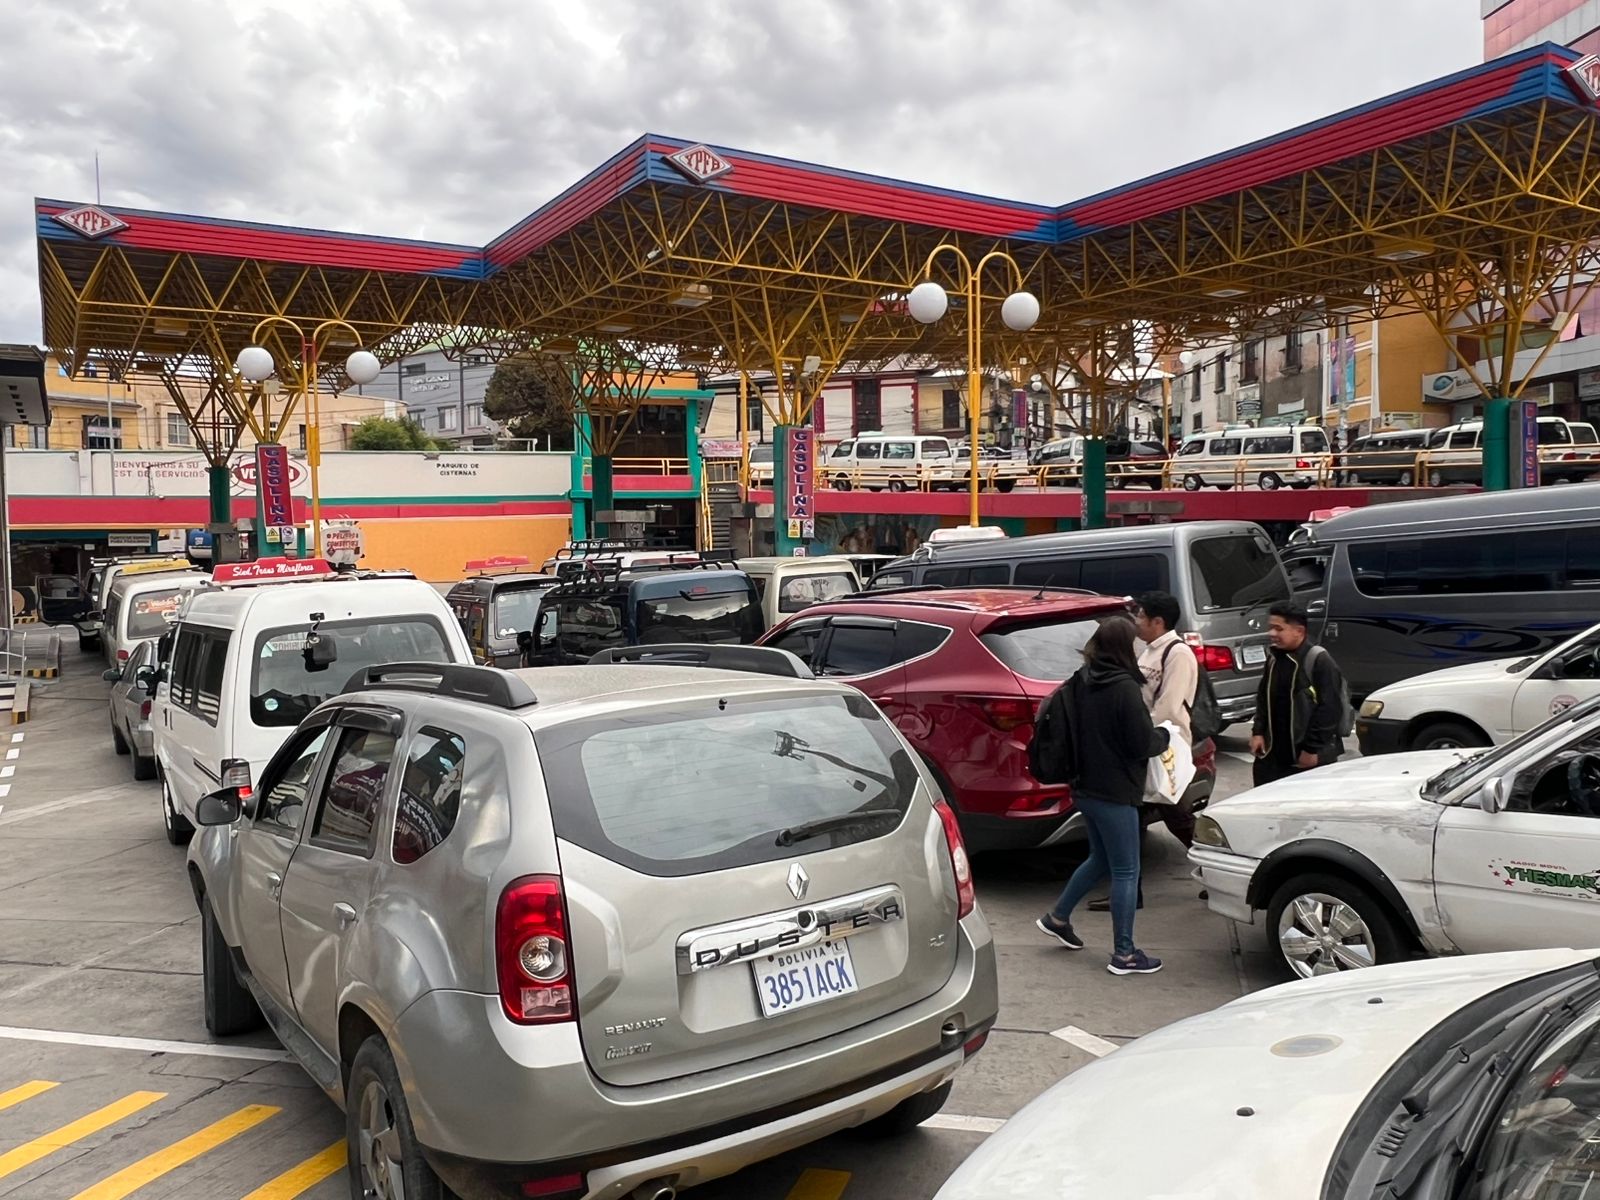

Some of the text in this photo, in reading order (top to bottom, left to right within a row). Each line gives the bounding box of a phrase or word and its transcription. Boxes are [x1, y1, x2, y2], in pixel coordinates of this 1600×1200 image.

[685, 150, 720, 175] YPFB
[71, 210, 112, 231] YPFB
[1525, 402, 1537, 486] DIESE
[155, 470, 205, 478] SERVICIOS
[178, 461, 184, 469] A
[186, 461, 199, 469] SU
[792, 431, 809, 518] GASOLINA
[264, 449, 287, 525] GASOLINA
[276, 563, 315, 576] Miraflores
[696, 903, 902, 967] DUSTER
[778, 946, 827, 968] BOLIVIA
[764, 955, 853, 1010] 3851ACK
[605, 1017, 667, 1036] RENAULT
